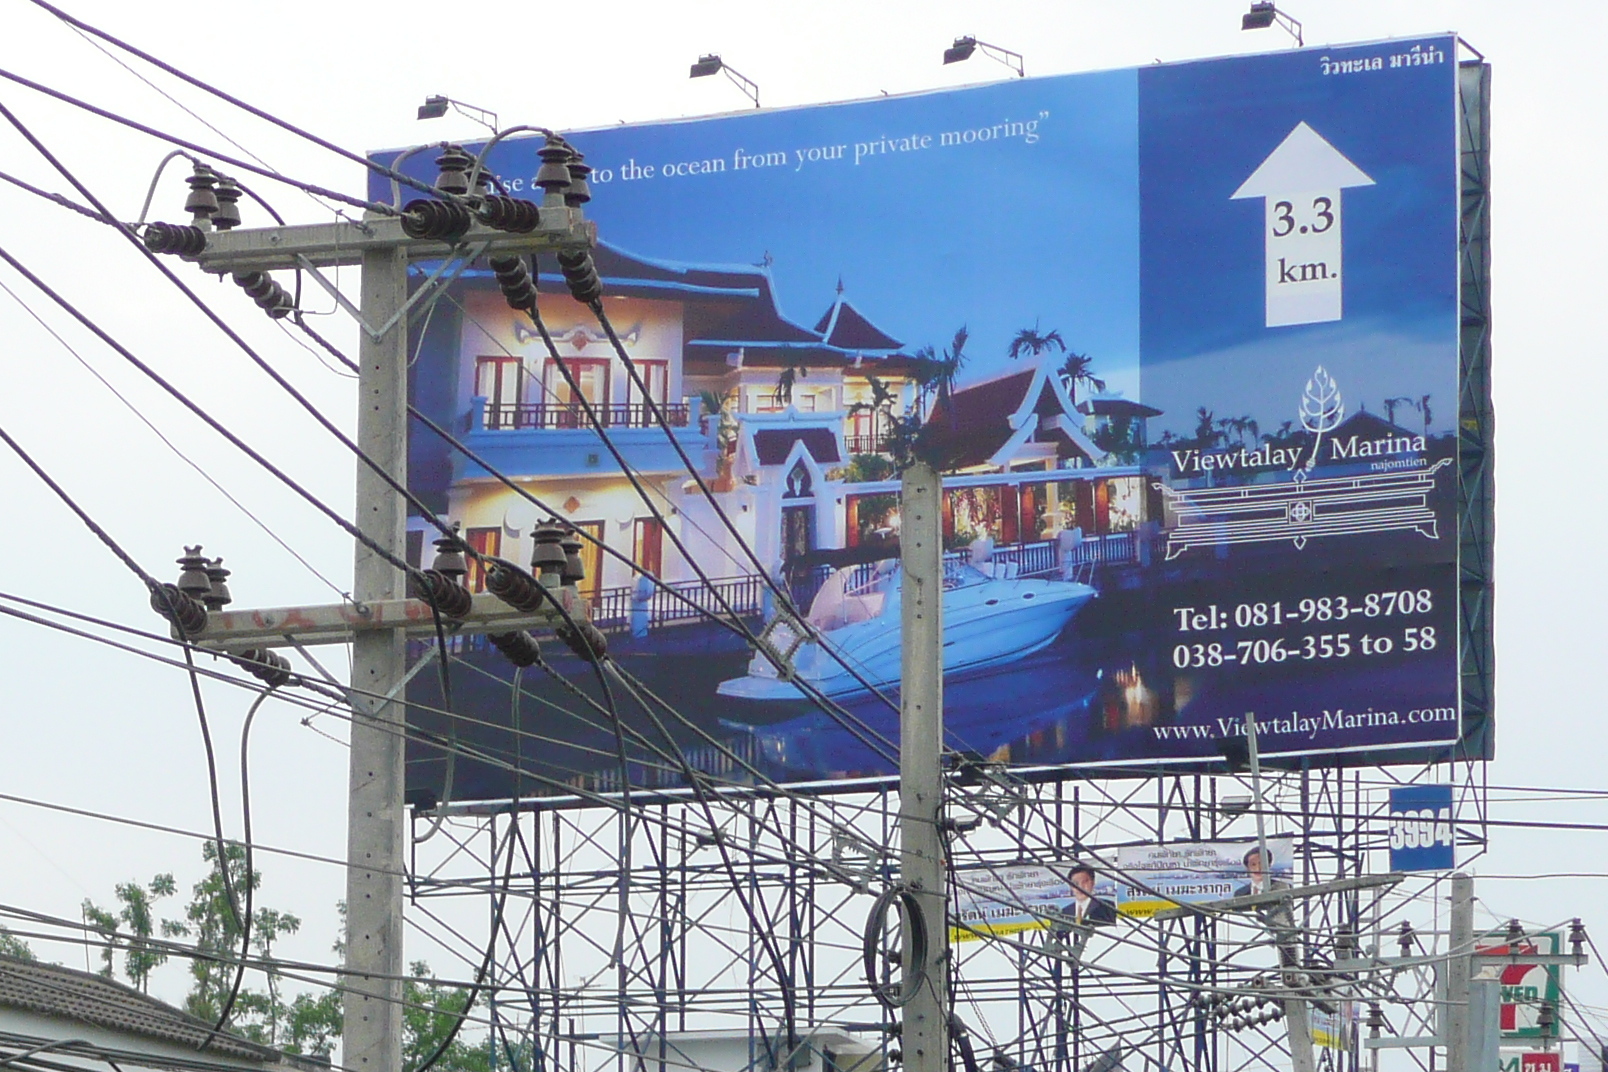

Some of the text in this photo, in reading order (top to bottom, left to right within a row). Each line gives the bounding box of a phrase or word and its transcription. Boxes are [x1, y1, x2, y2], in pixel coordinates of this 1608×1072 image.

[1320, 55, 1383, 76] วิวทะเล
[590, 166, 613, 185] to
[620, 157, 655, 181] the
[661, 156, 726, 178] ocean
[733, 147, 788, 171] from
[794, 142, 848, 173] your
[854, 133, 933, 166] private
[1271, 196, 1335, 238] 3.3
[1277, 257, 1338, 285] km.
[1170, 431, 1428, 475] Viewtalay Marina
[1370, 457, 1427, 473] najomtien
[1173, 588, 1433, 632] Tel: 081-983-8708
[1172, 625, 1437, 669] 038-706-355 to 58
[1152, 705, 1457, 741] www.ViewtalayMarina.com
[1389, 807, 1453, 851] 3994
